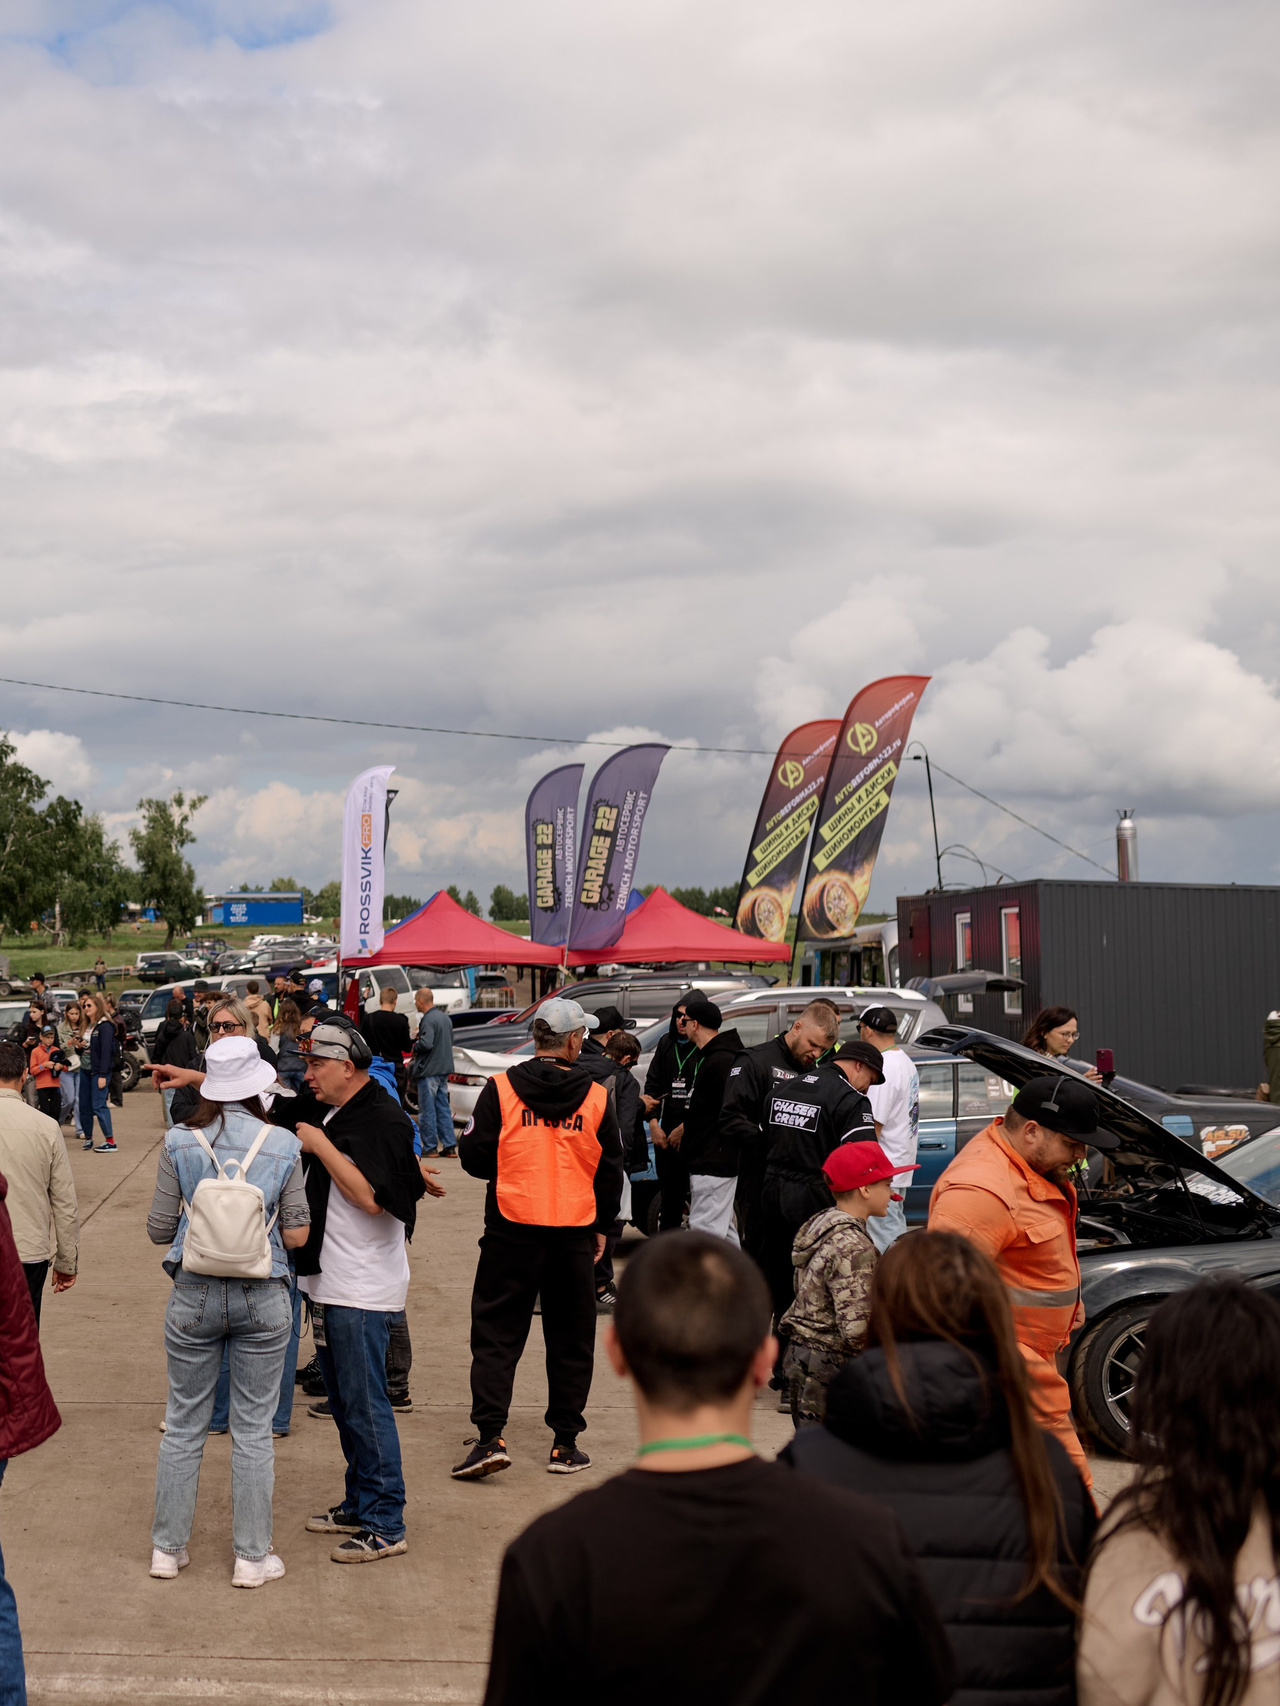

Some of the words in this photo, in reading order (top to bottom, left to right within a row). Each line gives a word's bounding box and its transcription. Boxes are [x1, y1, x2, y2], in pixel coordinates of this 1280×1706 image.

[594, 806, 618, 833] 22
[615, 789, 637, 852] АВТОСЕРВИС
[759, 831, 784, 855] ШИНЫ
[784, 822, 791, 832] И
[792, 799, 817, 828] ДИСКИ
[827, 802, 856, 833] ШИНЫ
[856, 795, 864, 806] И
[864, 766, 894, 798] ДИСКИ
[536, 823, 553, 845] 22
[556, 807, 565, 860] АВТОСЕРВИС
[565, 806, 575, 873] MOTORSPORT
[624, 790, 648, 869] MOTORSPORT
[755, 826, 807, 879] ШИНОМОНТАЖ
[822, 799, 883, 861] ШИНОМОНТАЖ
[359, 847, 372, 935] ROSSVIK
[536, 848, 554, 908] GARAGE
[565, 875, 574, 909] ZENICH
[580, 837, 613, 904] GARAGE
[616, 870, 633, 911] ZENICH
[773, 1100, 817, 1118] CHASER
[774, 1112, 810, 1127] CREW
